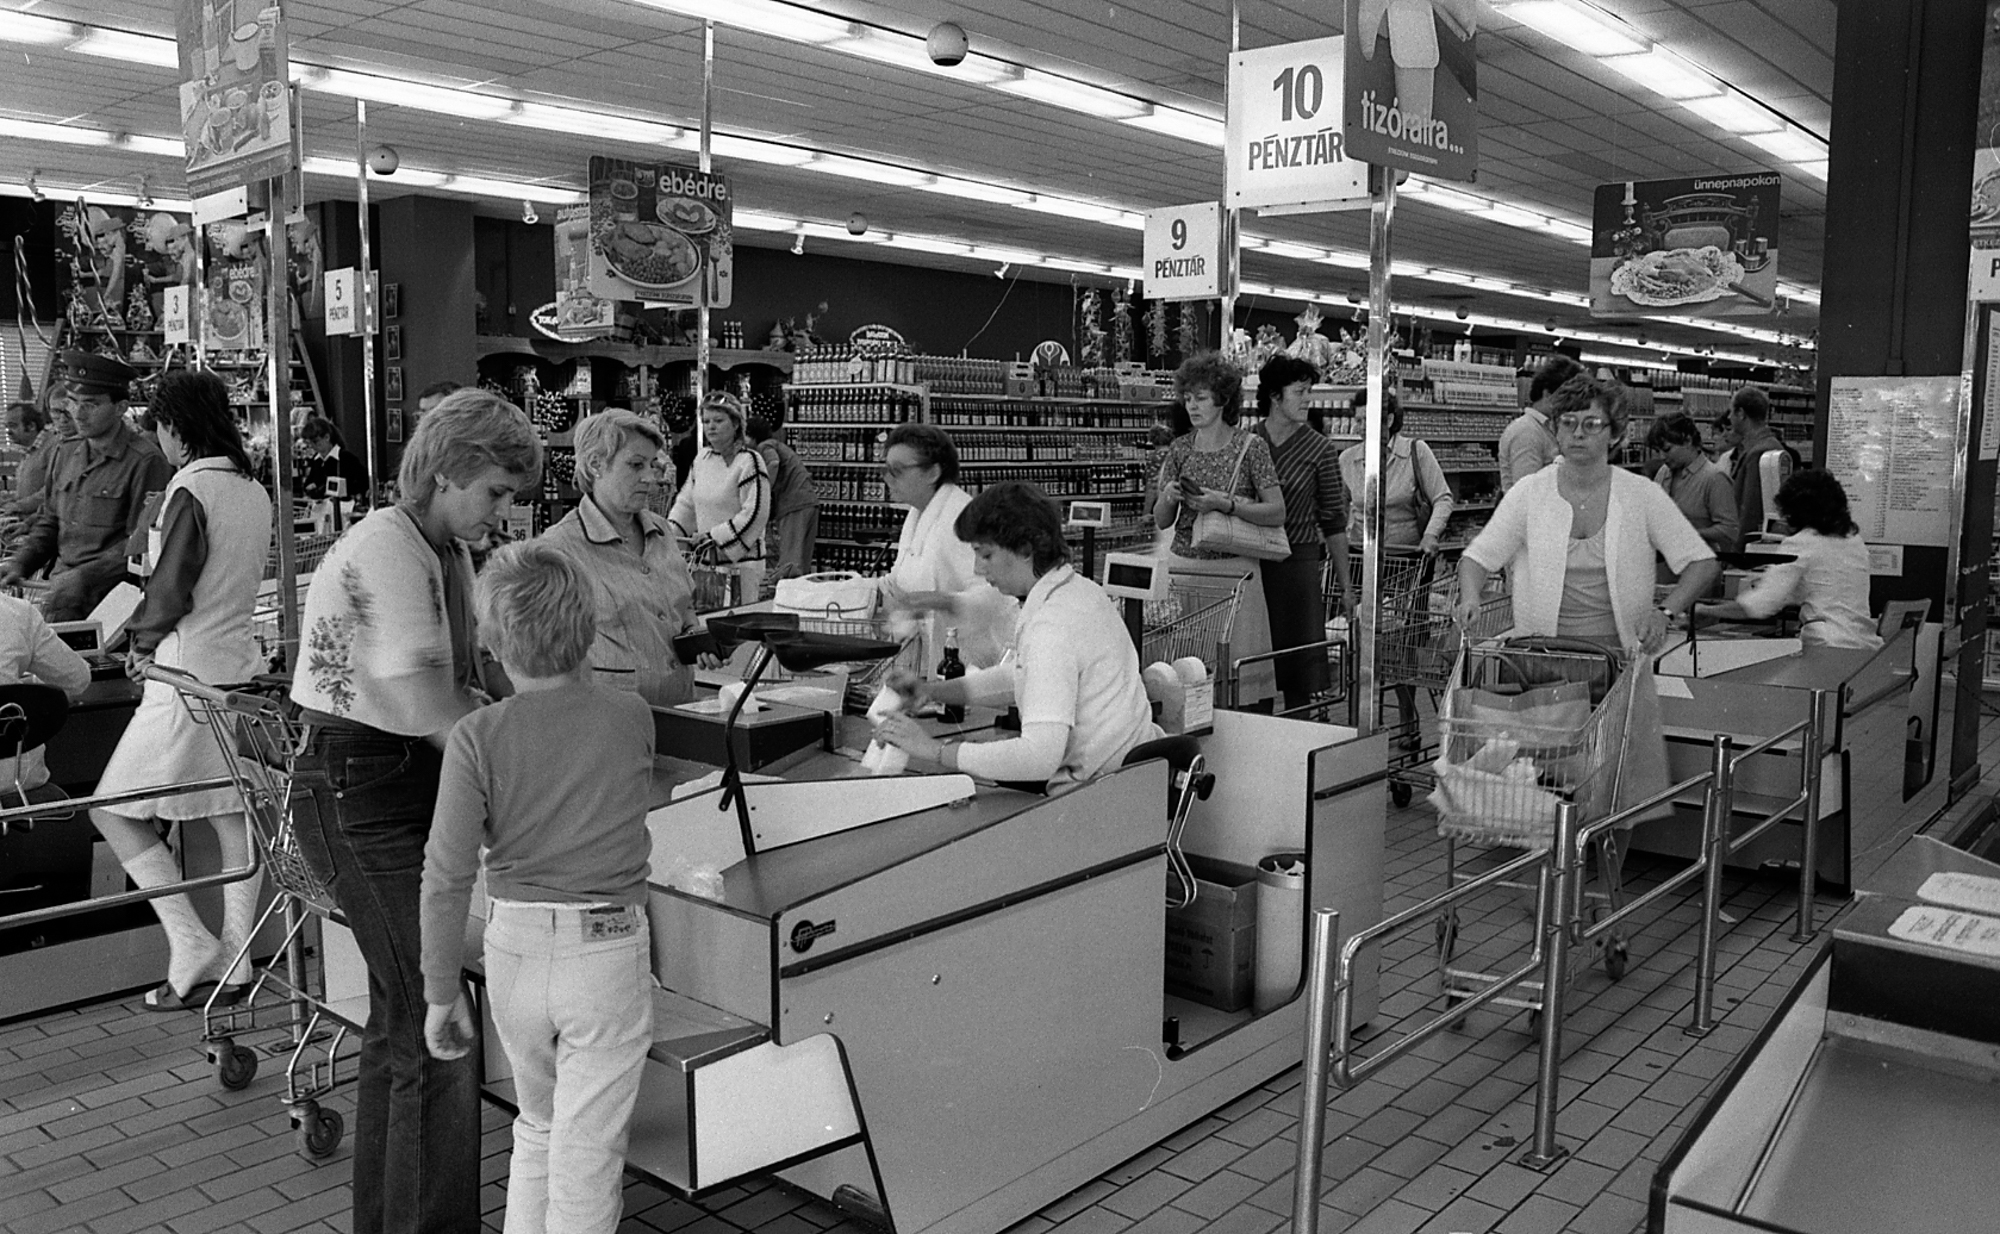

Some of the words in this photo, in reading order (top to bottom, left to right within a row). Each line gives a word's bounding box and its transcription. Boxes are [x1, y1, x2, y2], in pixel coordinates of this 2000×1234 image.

[1272, 64, 1323, 121] 10
[1248, 127, 1343, 171] PÉNZTÁR
[1694, 175, 1780, 191] ünnepnapokon
[1171, 218, 1187, 251] 9
[1155, 254, 1206, 279] PÉNZTÁR
[335, 279, 342, 301] 5
[173, 294, 180, 315] 3
